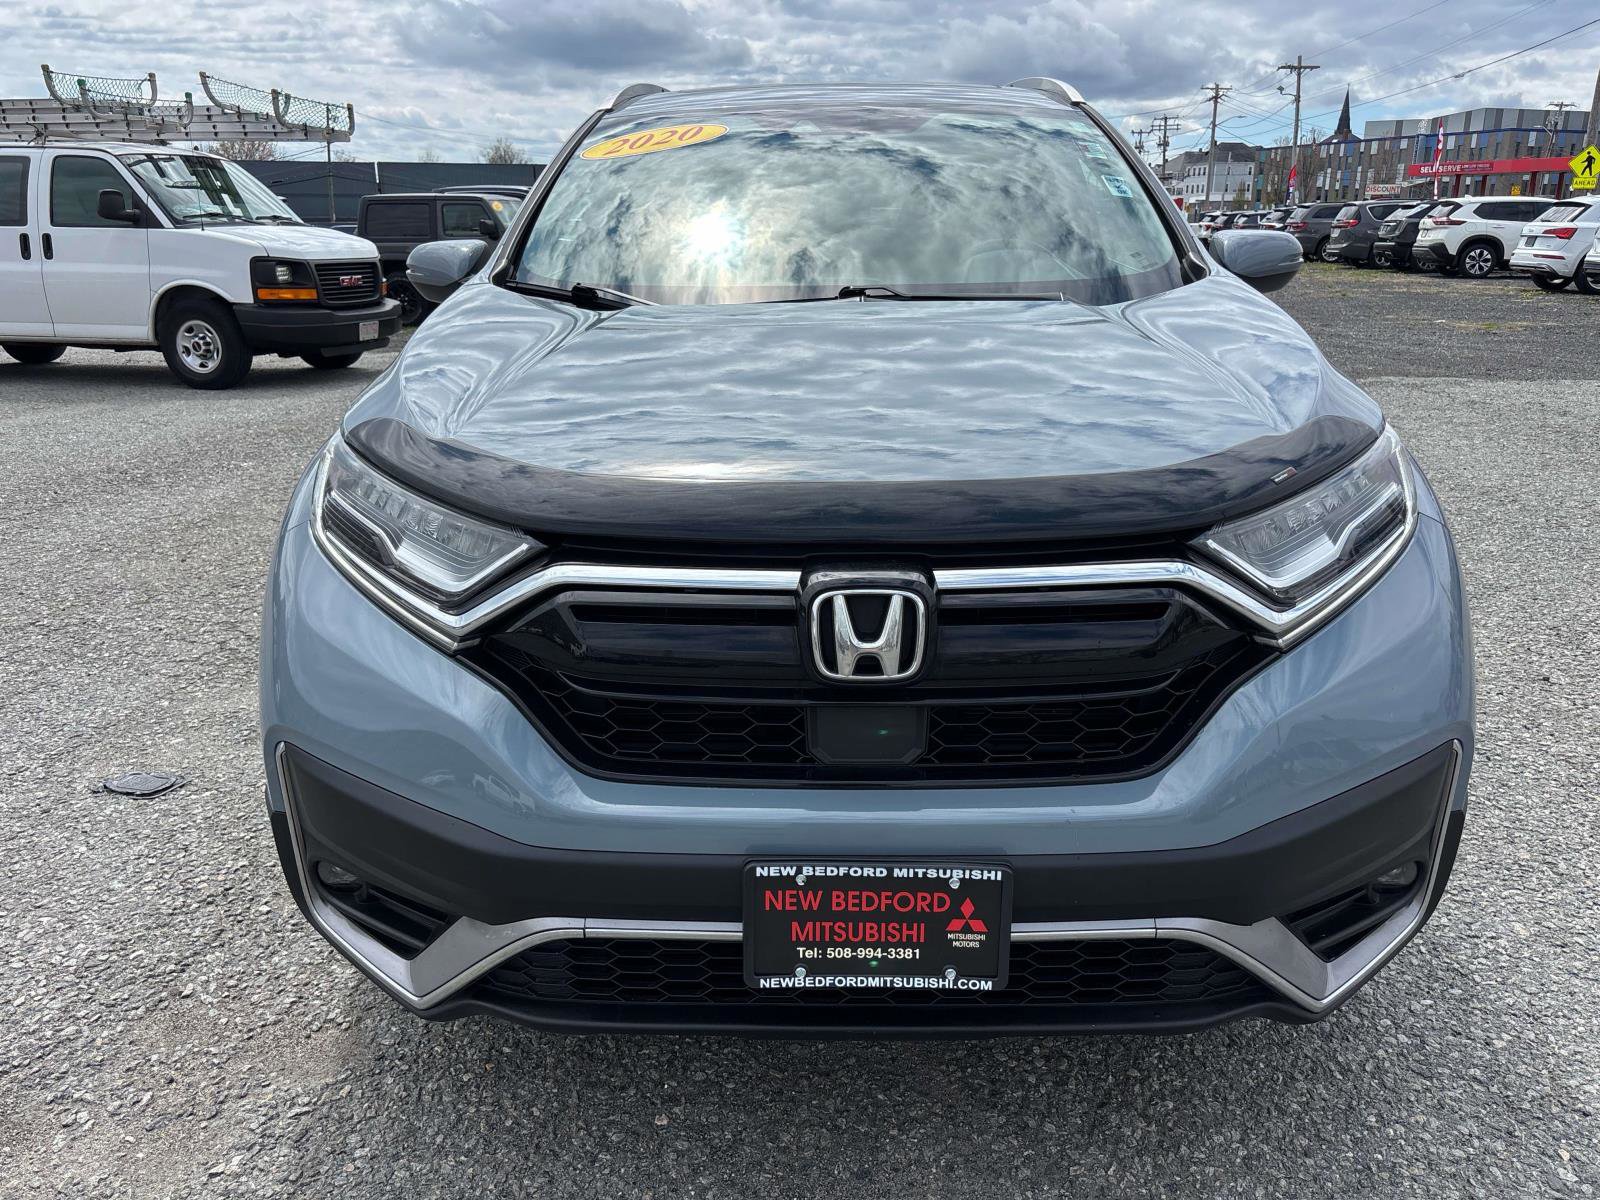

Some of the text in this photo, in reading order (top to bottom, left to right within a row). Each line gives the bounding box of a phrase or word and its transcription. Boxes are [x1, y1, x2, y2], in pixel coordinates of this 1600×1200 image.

[602, 126, 704, 156] 2020
[1438, 164, 1462, 173] SERVE
[1365, 185, 1401, 194] DISCOUNT
[340, 275, 363, 287] GMC
[755, 866, 1002, 881] NEW BEDFORD MITSUBISHI
[764, 889, 951, 913] NEW BEDFORD
[791, 921, 925, 943] MITSUBISHI
[947, 933, 986, 941] MITSUBISHI
[952, 940, 980, 948] MOTORS
[797, 947, 920, 960] Tel: 508-994-3381
[759, 976, 993, 991] NEWBEDFORDMITSUBISHI.COM
